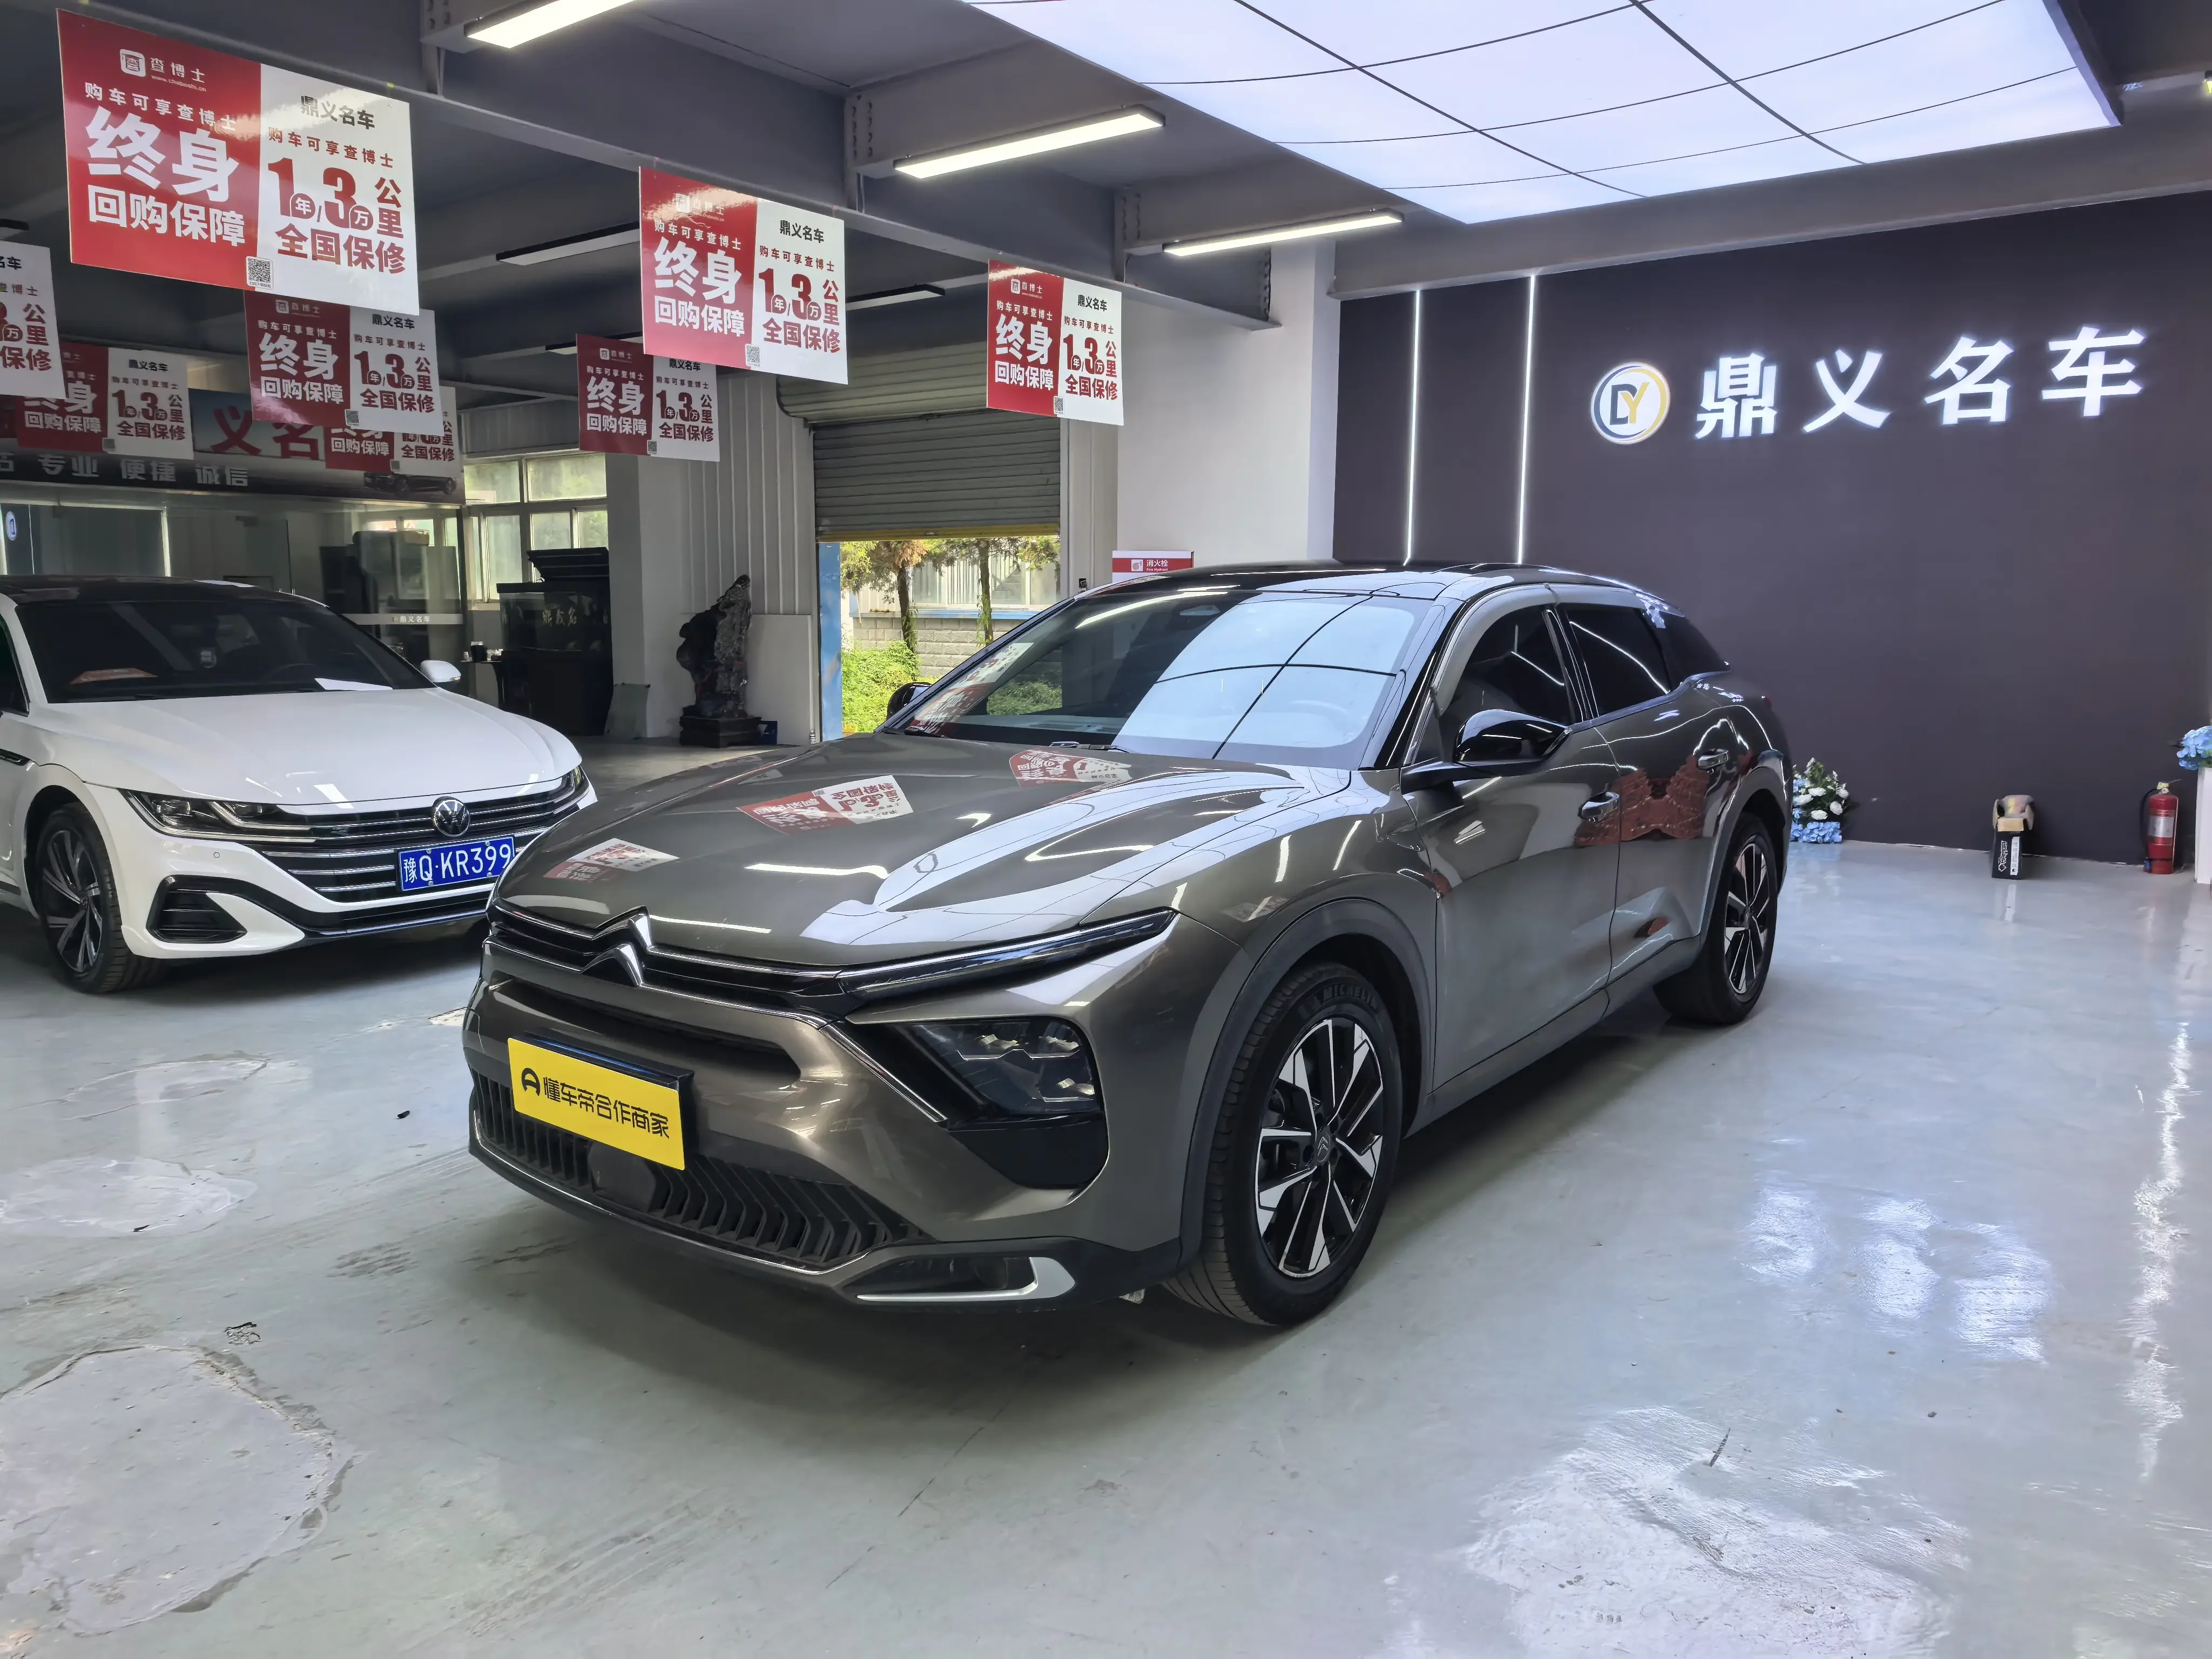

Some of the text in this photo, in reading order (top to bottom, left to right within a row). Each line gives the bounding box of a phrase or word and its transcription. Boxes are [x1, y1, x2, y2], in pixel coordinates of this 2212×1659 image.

[150, 57, 205, 83] 查博士
[85, 82, 237, 131] 购车可享查博士
[301, 95, 375, 130] 鼎义名车
[85, 105, 239, 202] 终身
[268, 126, 394, 168] 购车可享查博士
[88, 184, 245, 246] 回购保障
[655, 220, 741, 251] 购车可享查博士
[780, 220, 825, 244] 鼎义名车
[275, 222, 406, 274] 全国保修
[759, 245, 835, 272] 购车可享查博士
[654, 237, 742, 305] 终身
[654, 295, 745, 337] 回购保障
[996, 300, 1053, 321] 购车可享查博士
[1077, 294, 1108, 312] 鼎义名车
[763, 318, 841, 354] 全国保修
[995, 313, 1053, 365] 终身
[1064, 316, 1114, 334] 购车可享查博士
[259, 332, 339, 380] 终身
[260, 376, 344, 404] 回购保障
[995, 360, 1054, 391] 回购保障
[1065, 374, 1118, 401] 全国保修
[1694, 325, 2146, 441] 鼎义名车
[360, 388, 435, 413] 全国保修
[586, 376, 645, 415] 终身
[24, 411, 102, 433] 回购保障
[116, 420, 186, 441] 全国保修
[586, 413, 648, 436] 回购保障
[659, 422, 714, 442] 全国保修
[331, 437, 389, 456] 回购保障
[401, 444, 455, 462] 全国保修
[543, 1076, 670, 1139] 懂车帝合作商家
